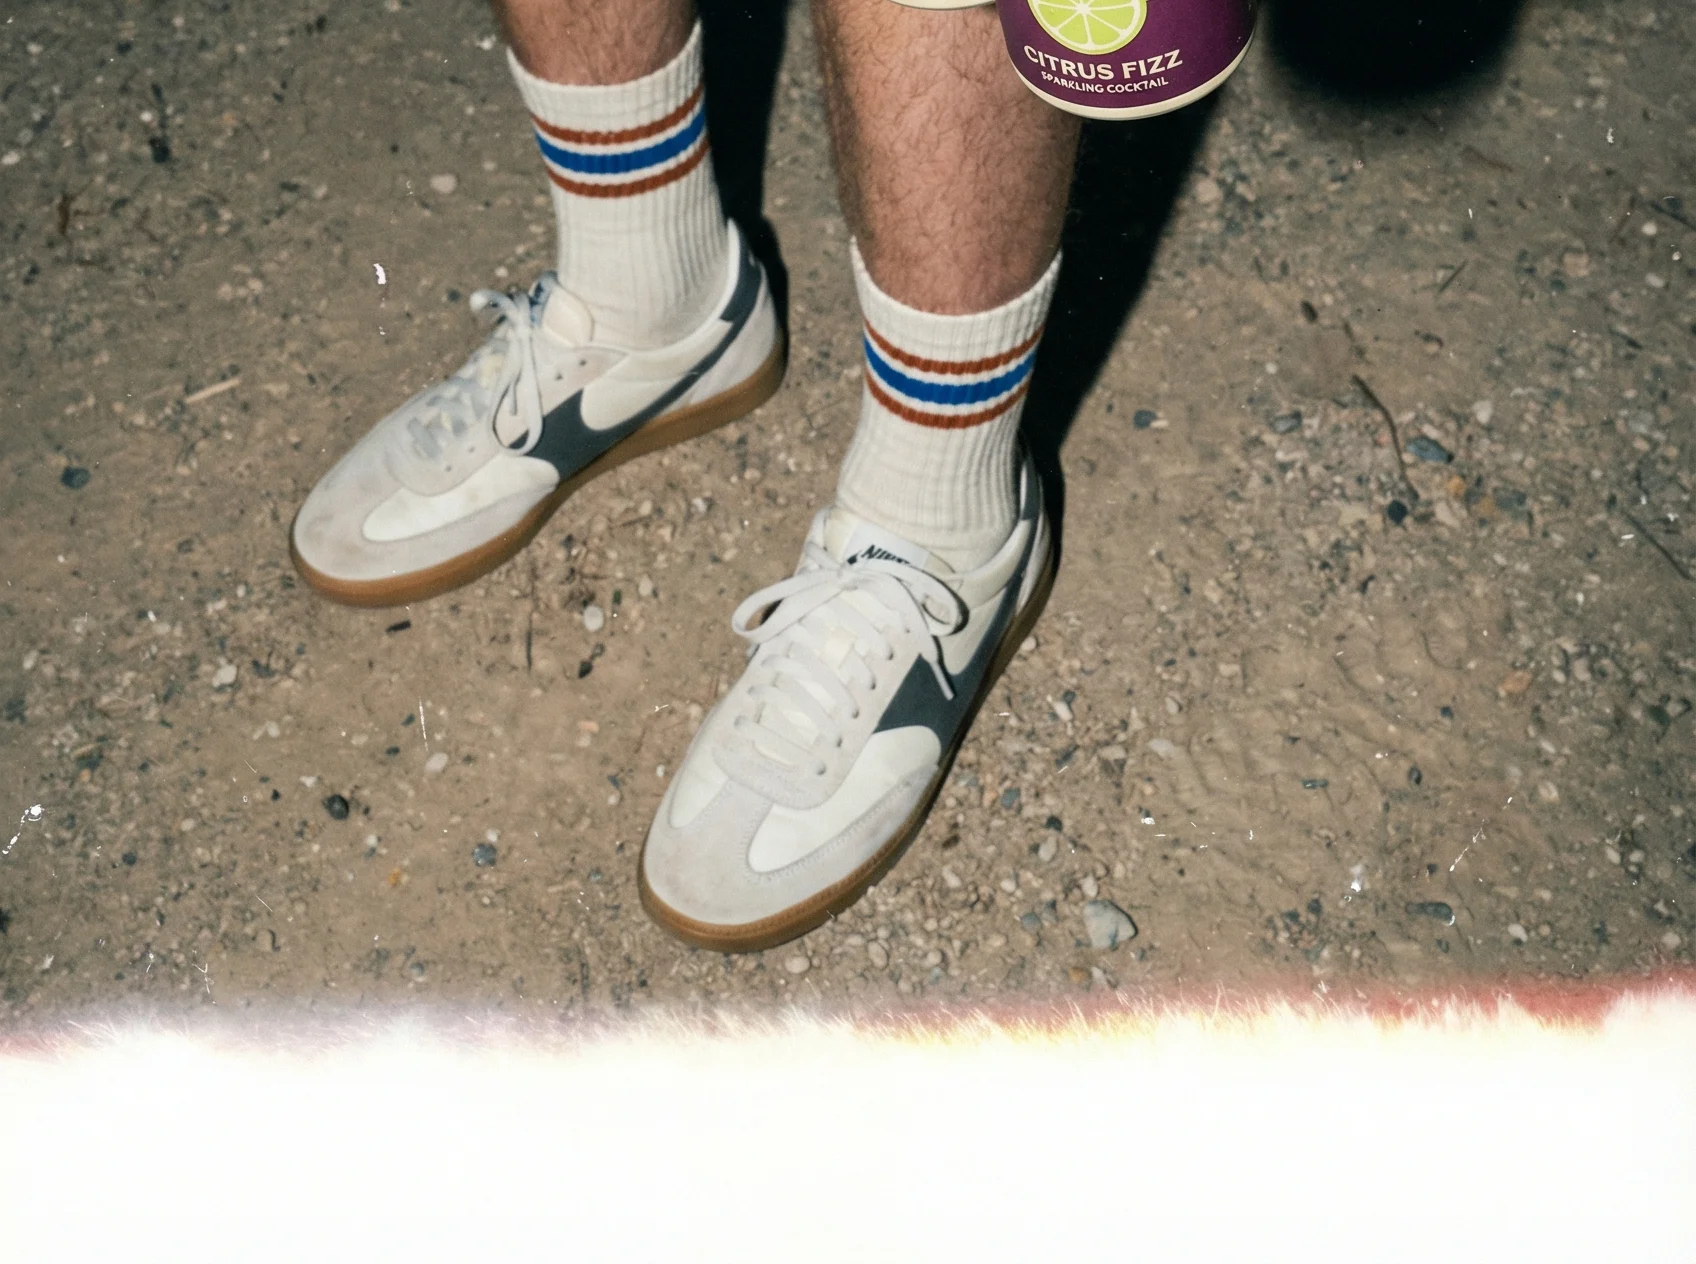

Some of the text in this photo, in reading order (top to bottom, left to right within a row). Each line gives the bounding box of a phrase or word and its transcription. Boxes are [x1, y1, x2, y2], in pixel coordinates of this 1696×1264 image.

[1023, 45, 1183, 80] CITRUS FIZZ
[1106, 76, 1169, 93] COCKTAIL
